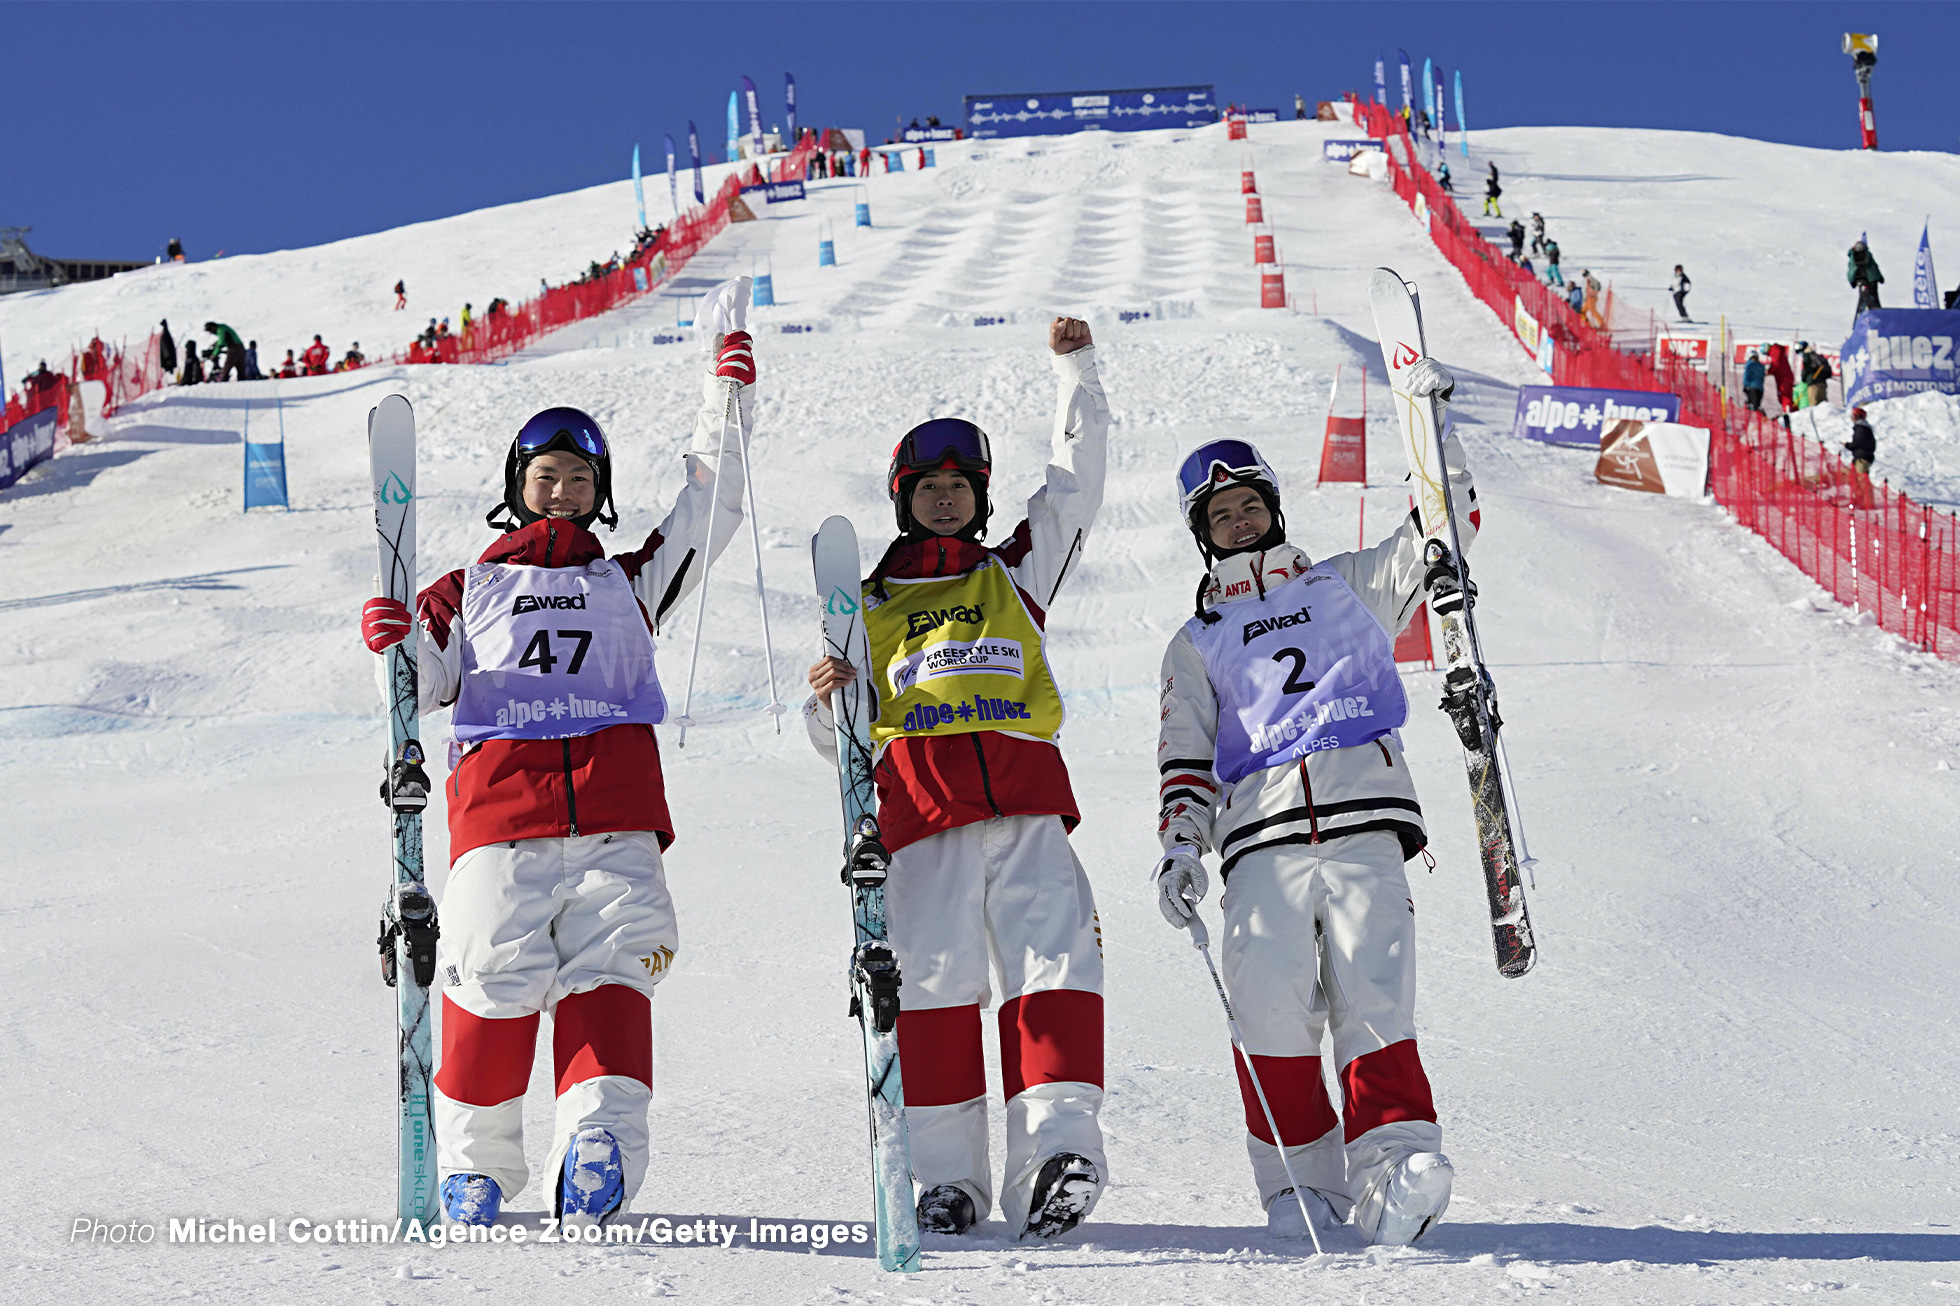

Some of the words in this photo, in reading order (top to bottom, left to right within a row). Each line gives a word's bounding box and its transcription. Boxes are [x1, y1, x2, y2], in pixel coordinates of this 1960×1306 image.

[1867, 328, 1955, 372] huez
[1525, 394, 1581, 434] alpe
[1225, 579, 1252, 598] ANTA
[518, 629, 593, 675] 47
[926, 645, 1000, 663] FREESTYLE
[1001, 645, 1020, 659] SKI
[928, 656, 968, 670] WORLD
[969, 655, 989, 665] CUP
[1271, 647, 1316, 695] 2
[496, 699, 546, 729] alpe
[568, 693, 628, 719] huez
[903, 703, 955, 732] alpe
[974, 694, 1032, 721] huez
[1250, 717, 1298, 754] alpe
[1312, 695, 1374, 732] huez
[1293, 735, 1340, 759] ALPES
